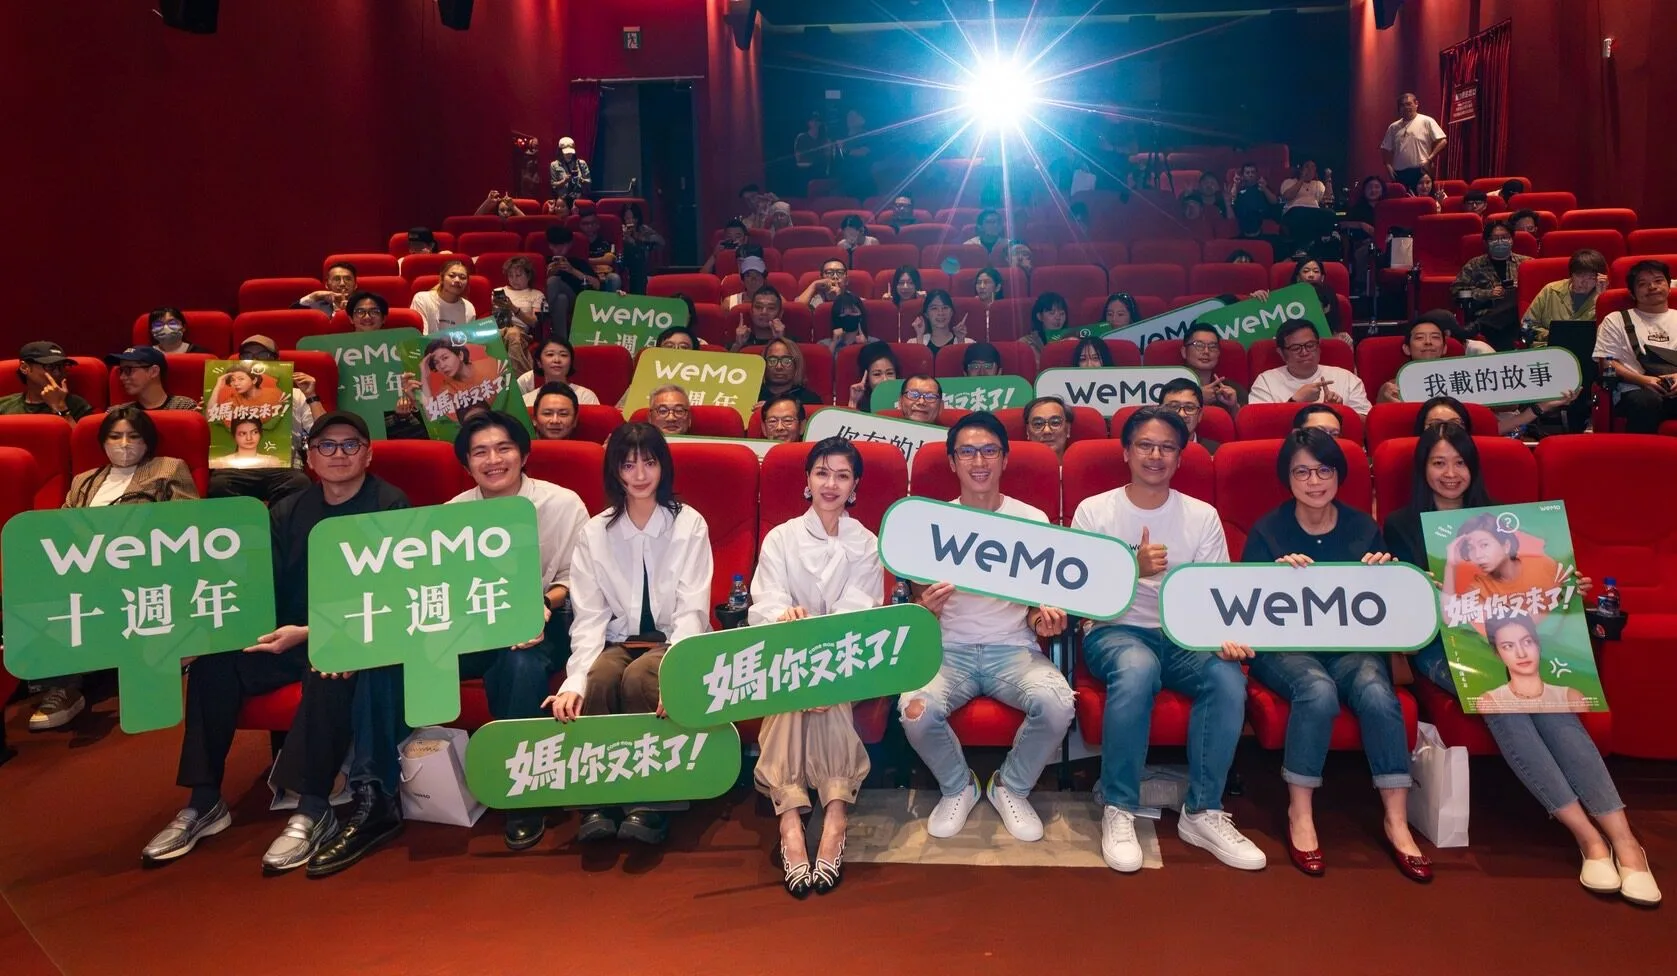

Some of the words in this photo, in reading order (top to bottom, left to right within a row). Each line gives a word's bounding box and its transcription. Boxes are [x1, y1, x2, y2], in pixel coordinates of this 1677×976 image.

[589, 303, 673, 329] WeMo
[1213, 301, 1306, 341] WeMo
[338, 371, 403, 401] 週年
[655, 360, 747, 385] WeMo
[1424, 361, 1553, 399] 我載的故事
[207, 401, 290, 422] 媽你又來了!
[425, 373, 512, 421] 媽你又來了!
[40, 525, 241, 576] WeMo
[339, 525, 512, 576] WeMo
[930, 523, 1089, 590] WeMo
[47, 578, 241, 648] 十週年
[343, 576, 512, 644] 十週年
[1210, 586, 1387, 627] WeMo
[1444, 585, 1575, 628] 媽你又來了!
[702, 625, 911, 714] 媽你又來了!
[505, 732, 709, 797] 媽你又來了!
